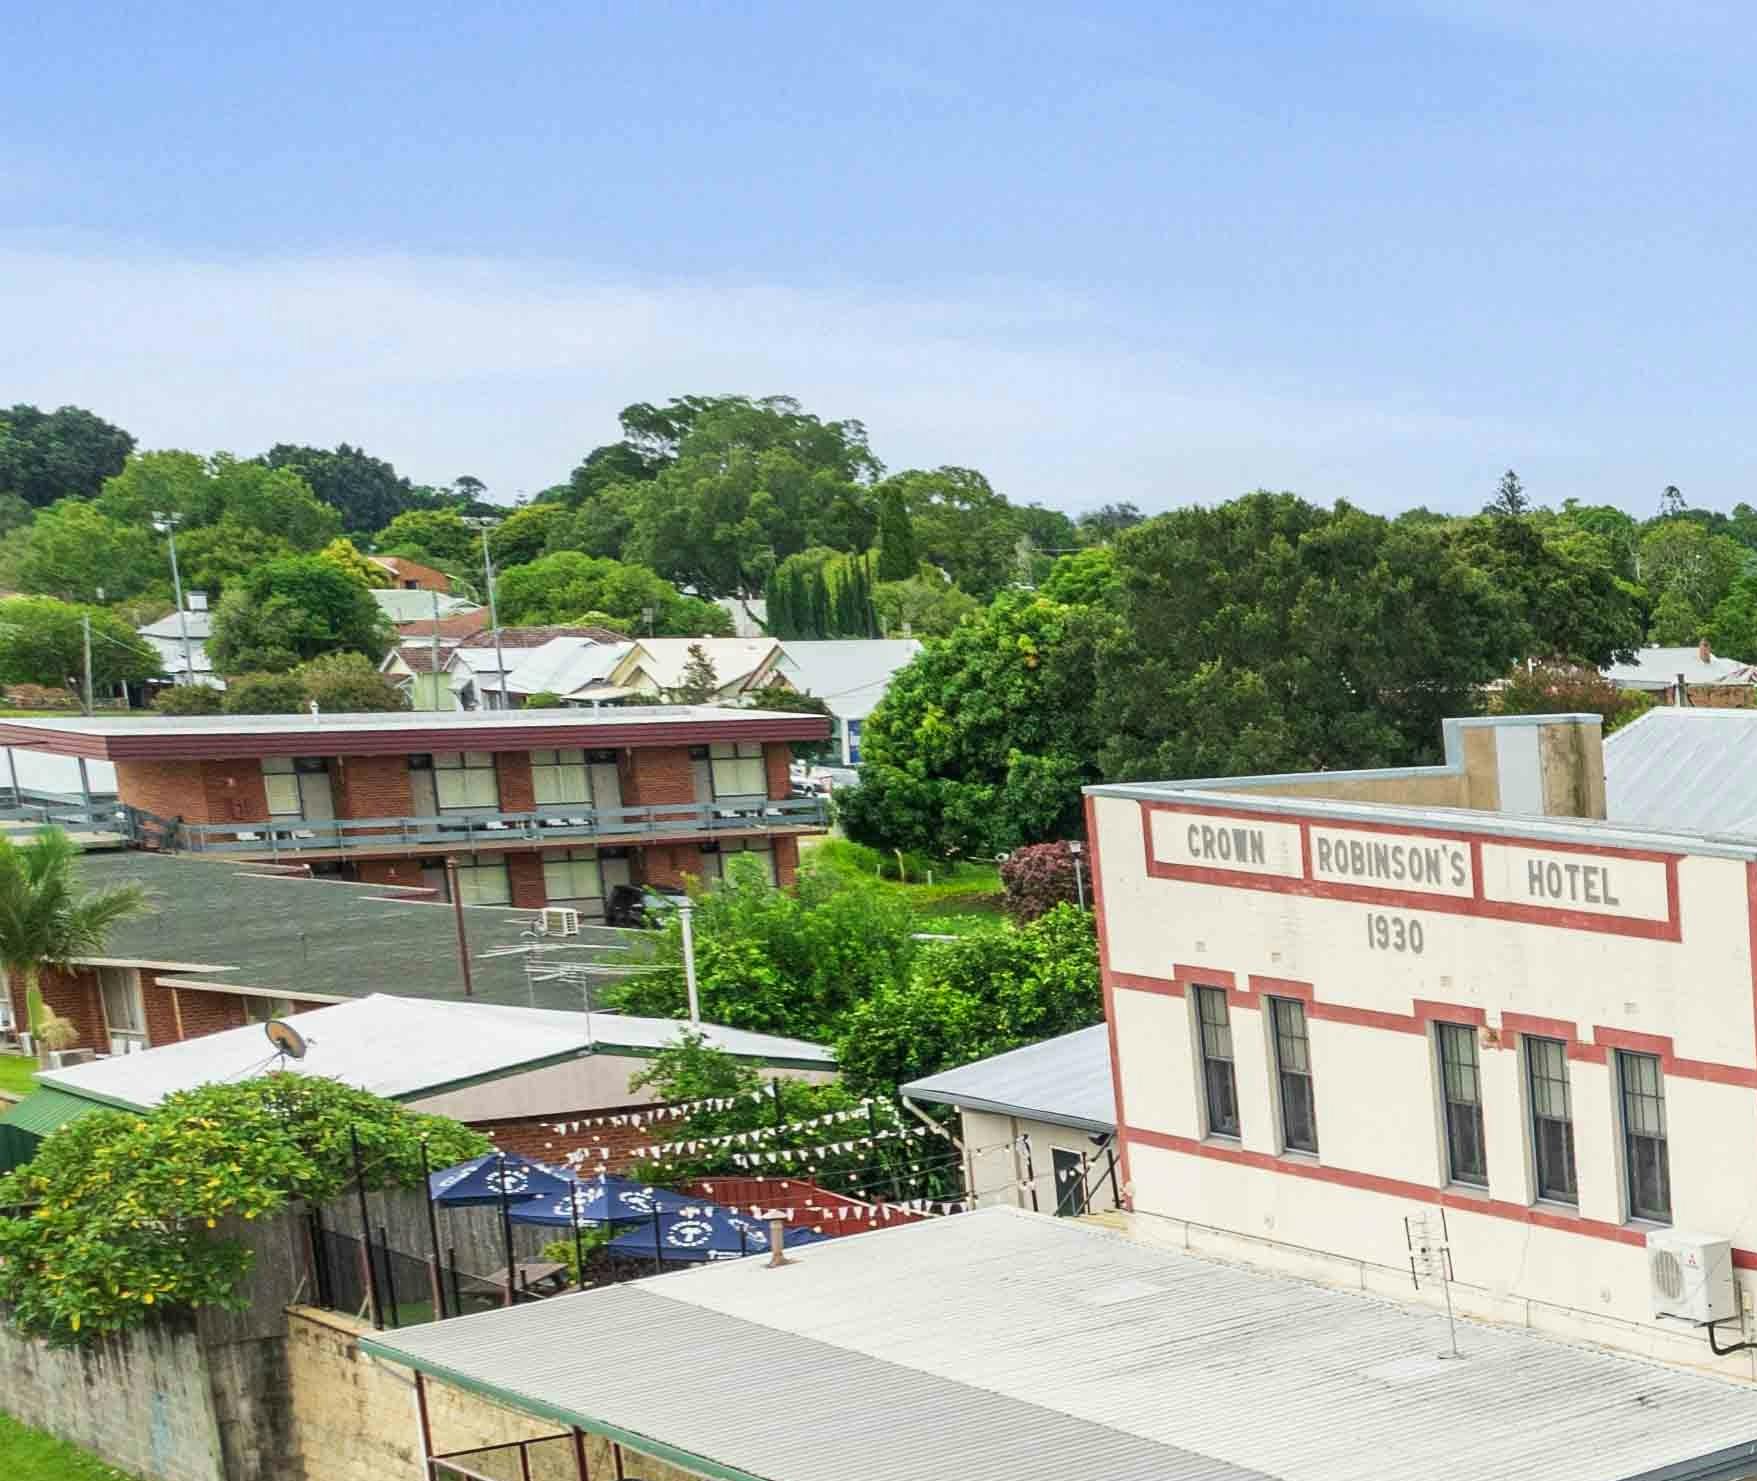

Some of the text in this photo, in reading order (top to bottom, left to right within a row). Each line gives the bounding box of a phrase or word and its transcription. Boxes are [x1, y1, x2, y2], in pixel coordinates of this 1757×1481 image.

[1187, 823, 1620, 906] CROWN ROBINSON'S HOTEL
[1367, 912, 1425, 954] 1930
